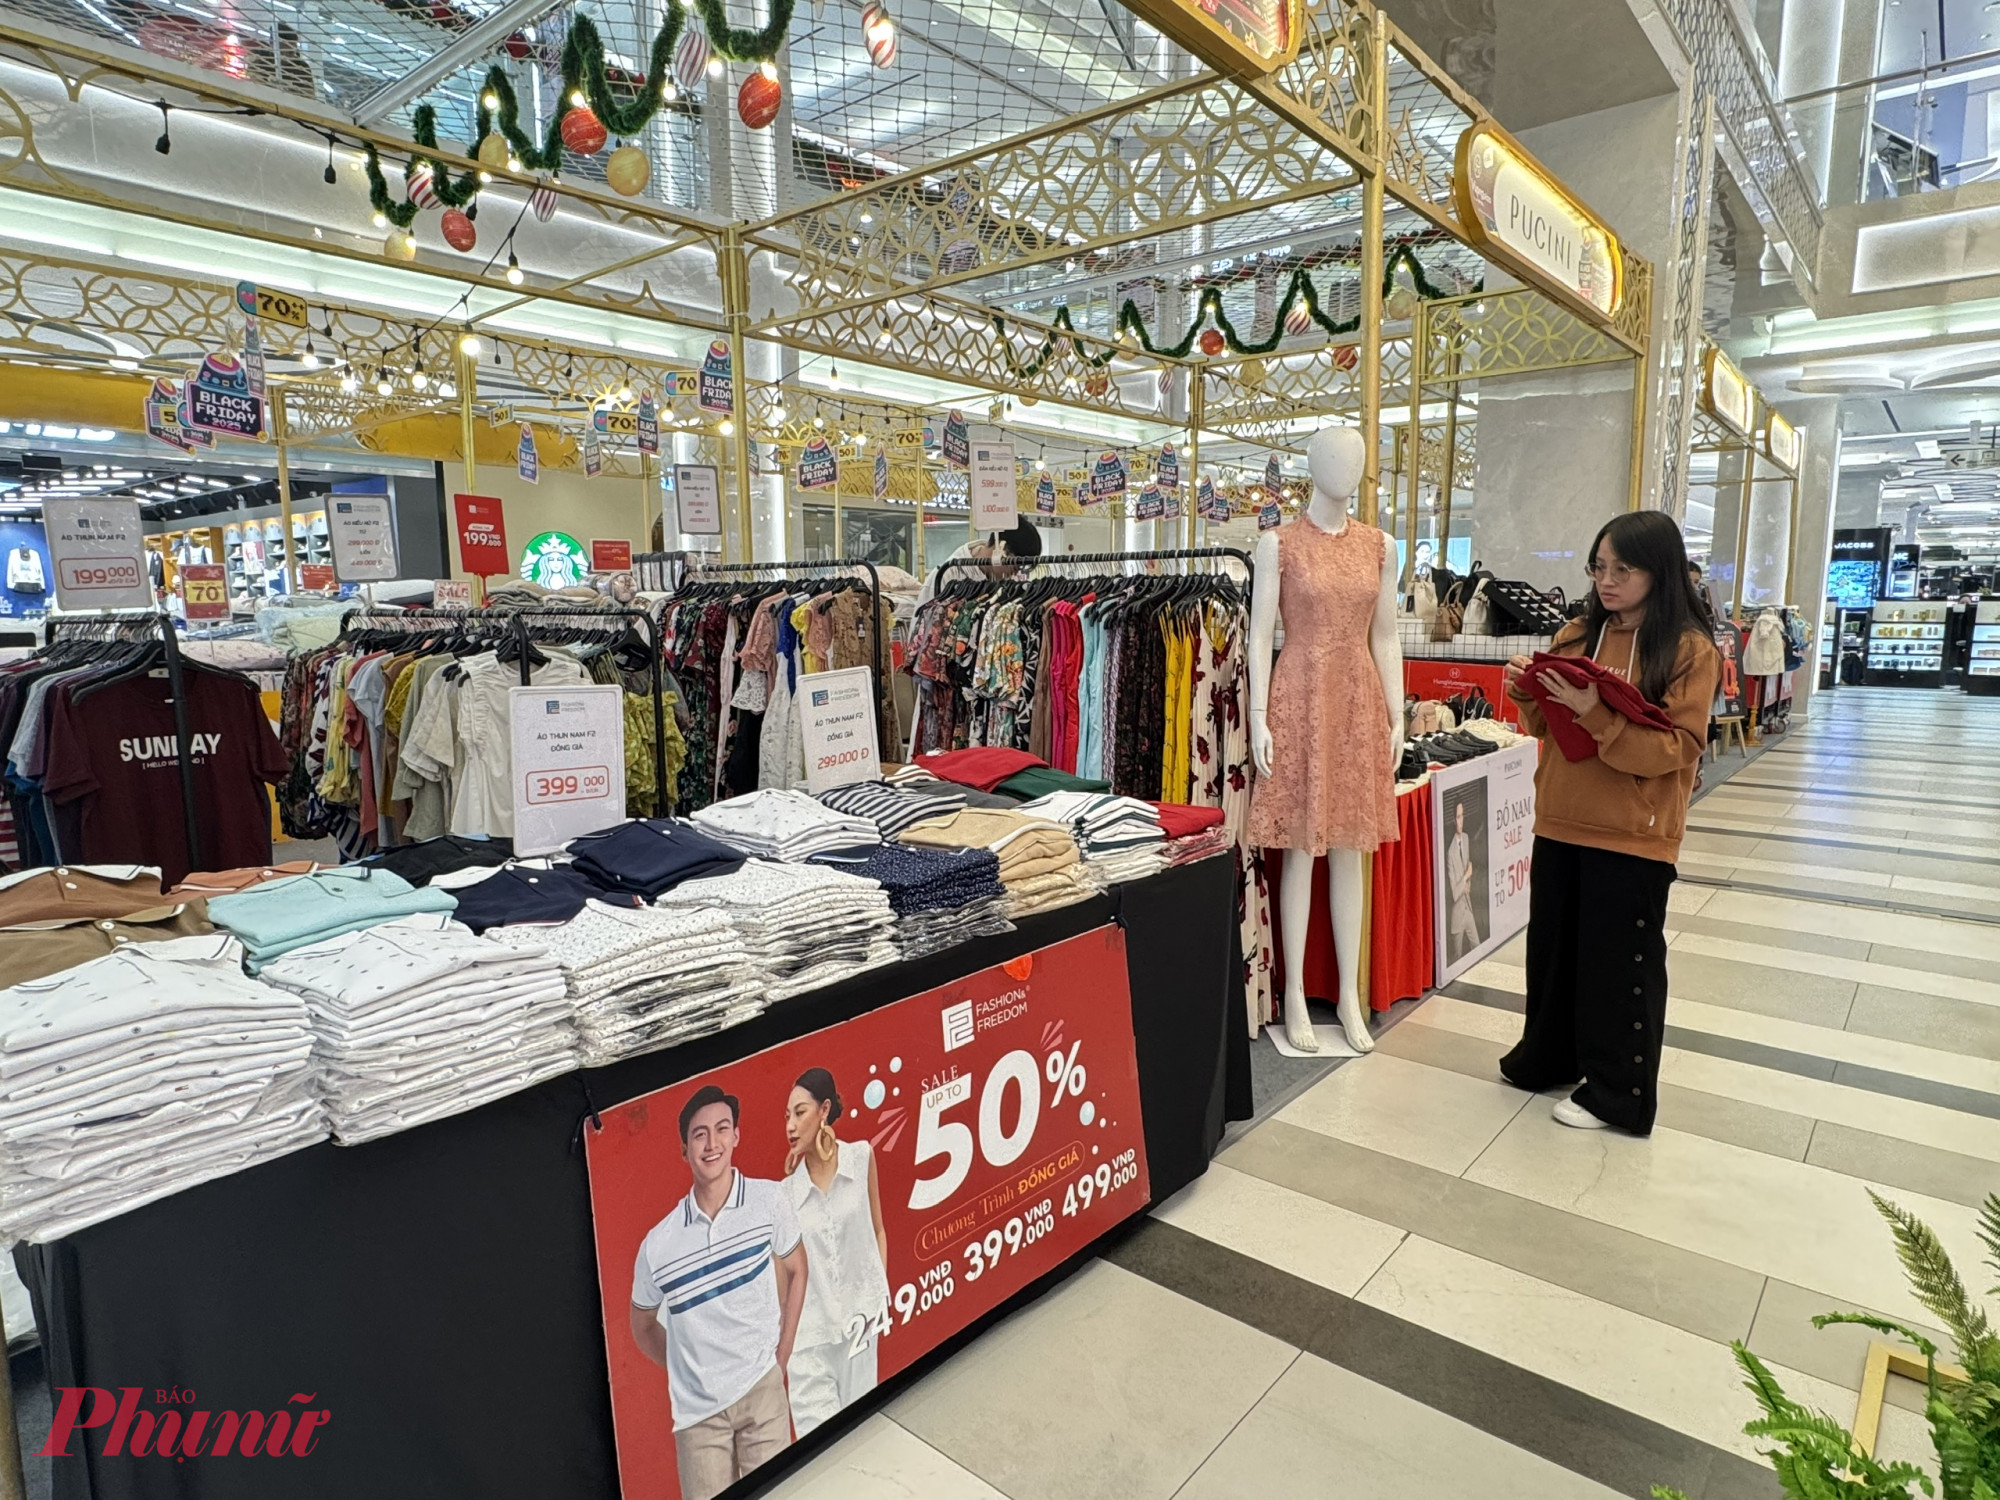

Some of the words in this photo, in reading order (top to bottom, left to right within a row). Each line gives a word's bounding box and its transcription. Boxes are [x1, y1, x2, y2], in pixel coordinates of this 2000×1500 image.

[1511, 194, 1571, 270] PUCINI
[200, 391, 252, 412] BLACK
[702, 387, 732, 400] FRIDA
[195, 402, 257, 424] FRIDAY
[211, 416, 242, 431] 2025
[801, 468, 834, 482] FRIDAY
[803, 460, 831, 473] BLACK
[1159, 465, 1177, 474] BLACK
[1093, 479, 1124, 491] FRIDAY
[1094, 473, 1122, 484] BLACK
[463, 532, 488, 546] 199
[72, 568, 108, 585] 199
[825, 716, 841, 725] THUN
[841, 713, 855, 721] NAM
[550, 731, 569, 739] THUN
[587, 730, 596, 738] F2
[817, 750, 858, 770] 299.000
[536, 776, 578, 797] 399
[584, 775, 605, 786] 000
[1511, 796, 1532, 822] NAM
[1504, 826, 1523, 850] SALE
[1494, 868, 1505, 887] UP
[1495, 890, 1506, 908] TO
[976, 1002, 1028, 1032] FREEDOM
[921, 1064, 960, 1093] SALE
[926, 1091, 944, 1109] UP
[946, 1083, 962, 1100] TO
[1112, 1148, 1136, 1170] VNĐ
[979, 1185, 1015, 1217] Trình
[1017, 1163, 1056, 1195] ĐỒNG
[1058, 1146, 1080, 1171] GIÁ
[1062, 1163, 1111, 1218] 499
[1024, 1198, 1052, 1224] VNĐ
[963, 1217, 1024, 1282] 399
[919, 1260, 952, 1290] VNĐ
[847, 1283, 917, 1360] 249
